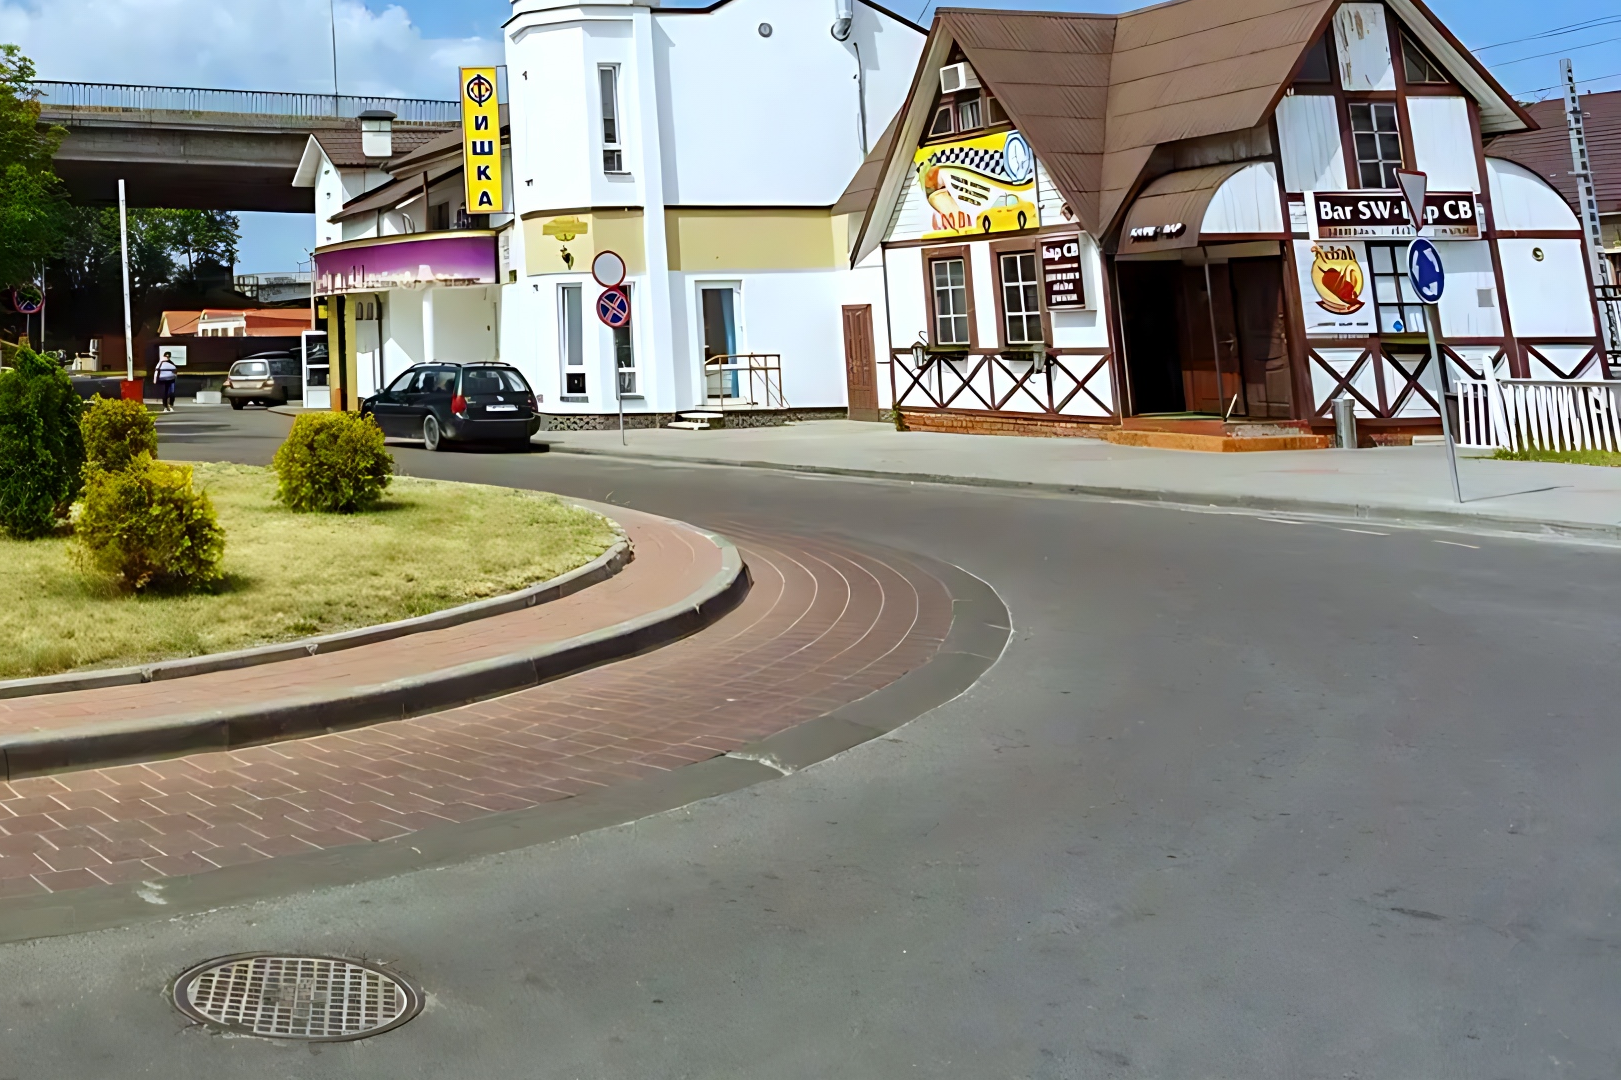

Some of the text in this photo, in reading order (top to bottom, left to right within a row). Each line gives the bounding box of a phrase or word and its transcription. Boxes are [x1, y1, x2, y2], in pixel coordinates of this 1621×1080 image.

[467, 74, 494, 206] ФИШКА
[1319, 201, 1353, 220] Bar
[1358, 201, 1391, 220] SW
